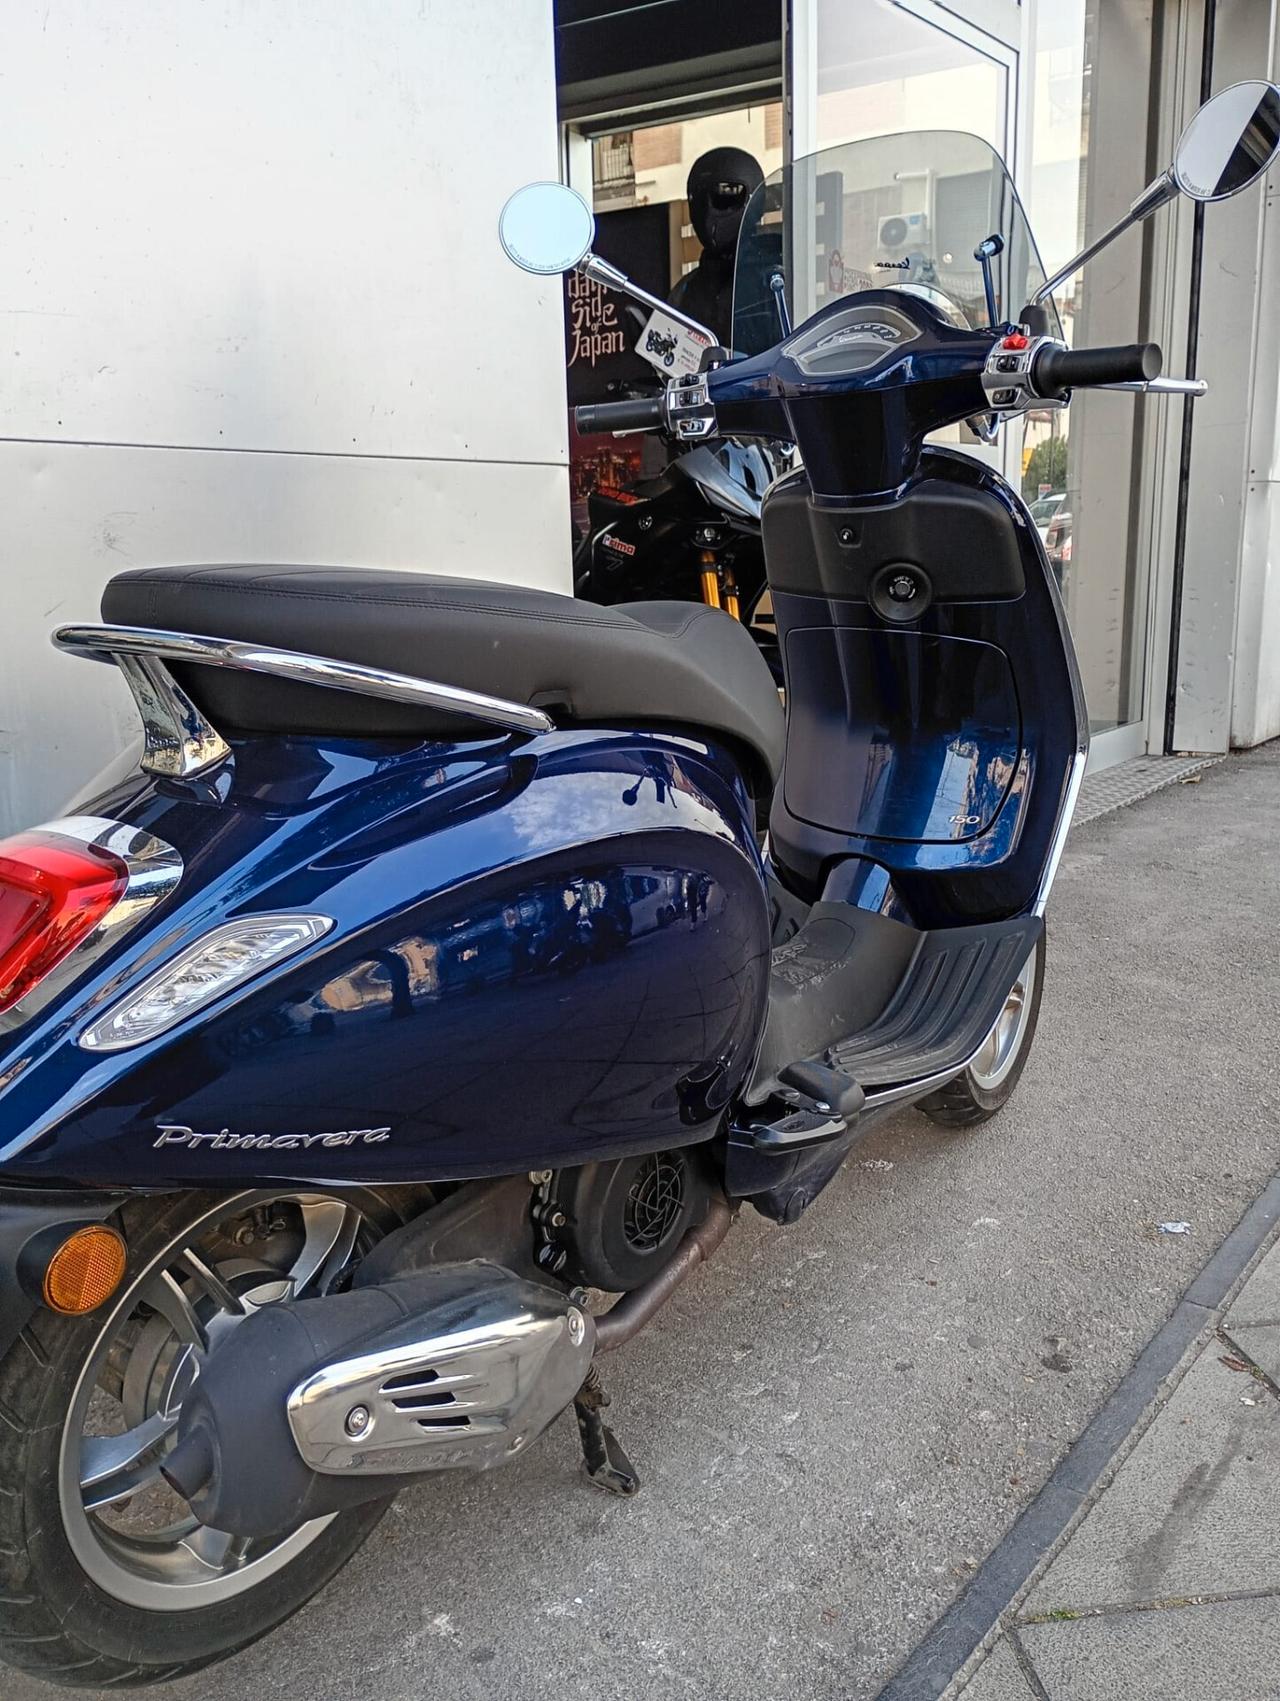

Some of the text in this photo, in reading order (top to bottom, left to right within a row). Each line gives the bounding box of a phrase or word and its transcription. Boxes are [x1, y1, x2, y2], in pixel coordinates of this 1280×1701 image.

[567, 328, 625, 368] Japan
[949, 815, 980, 824] 150
[152, 1124, 391, 1149] Primavera
